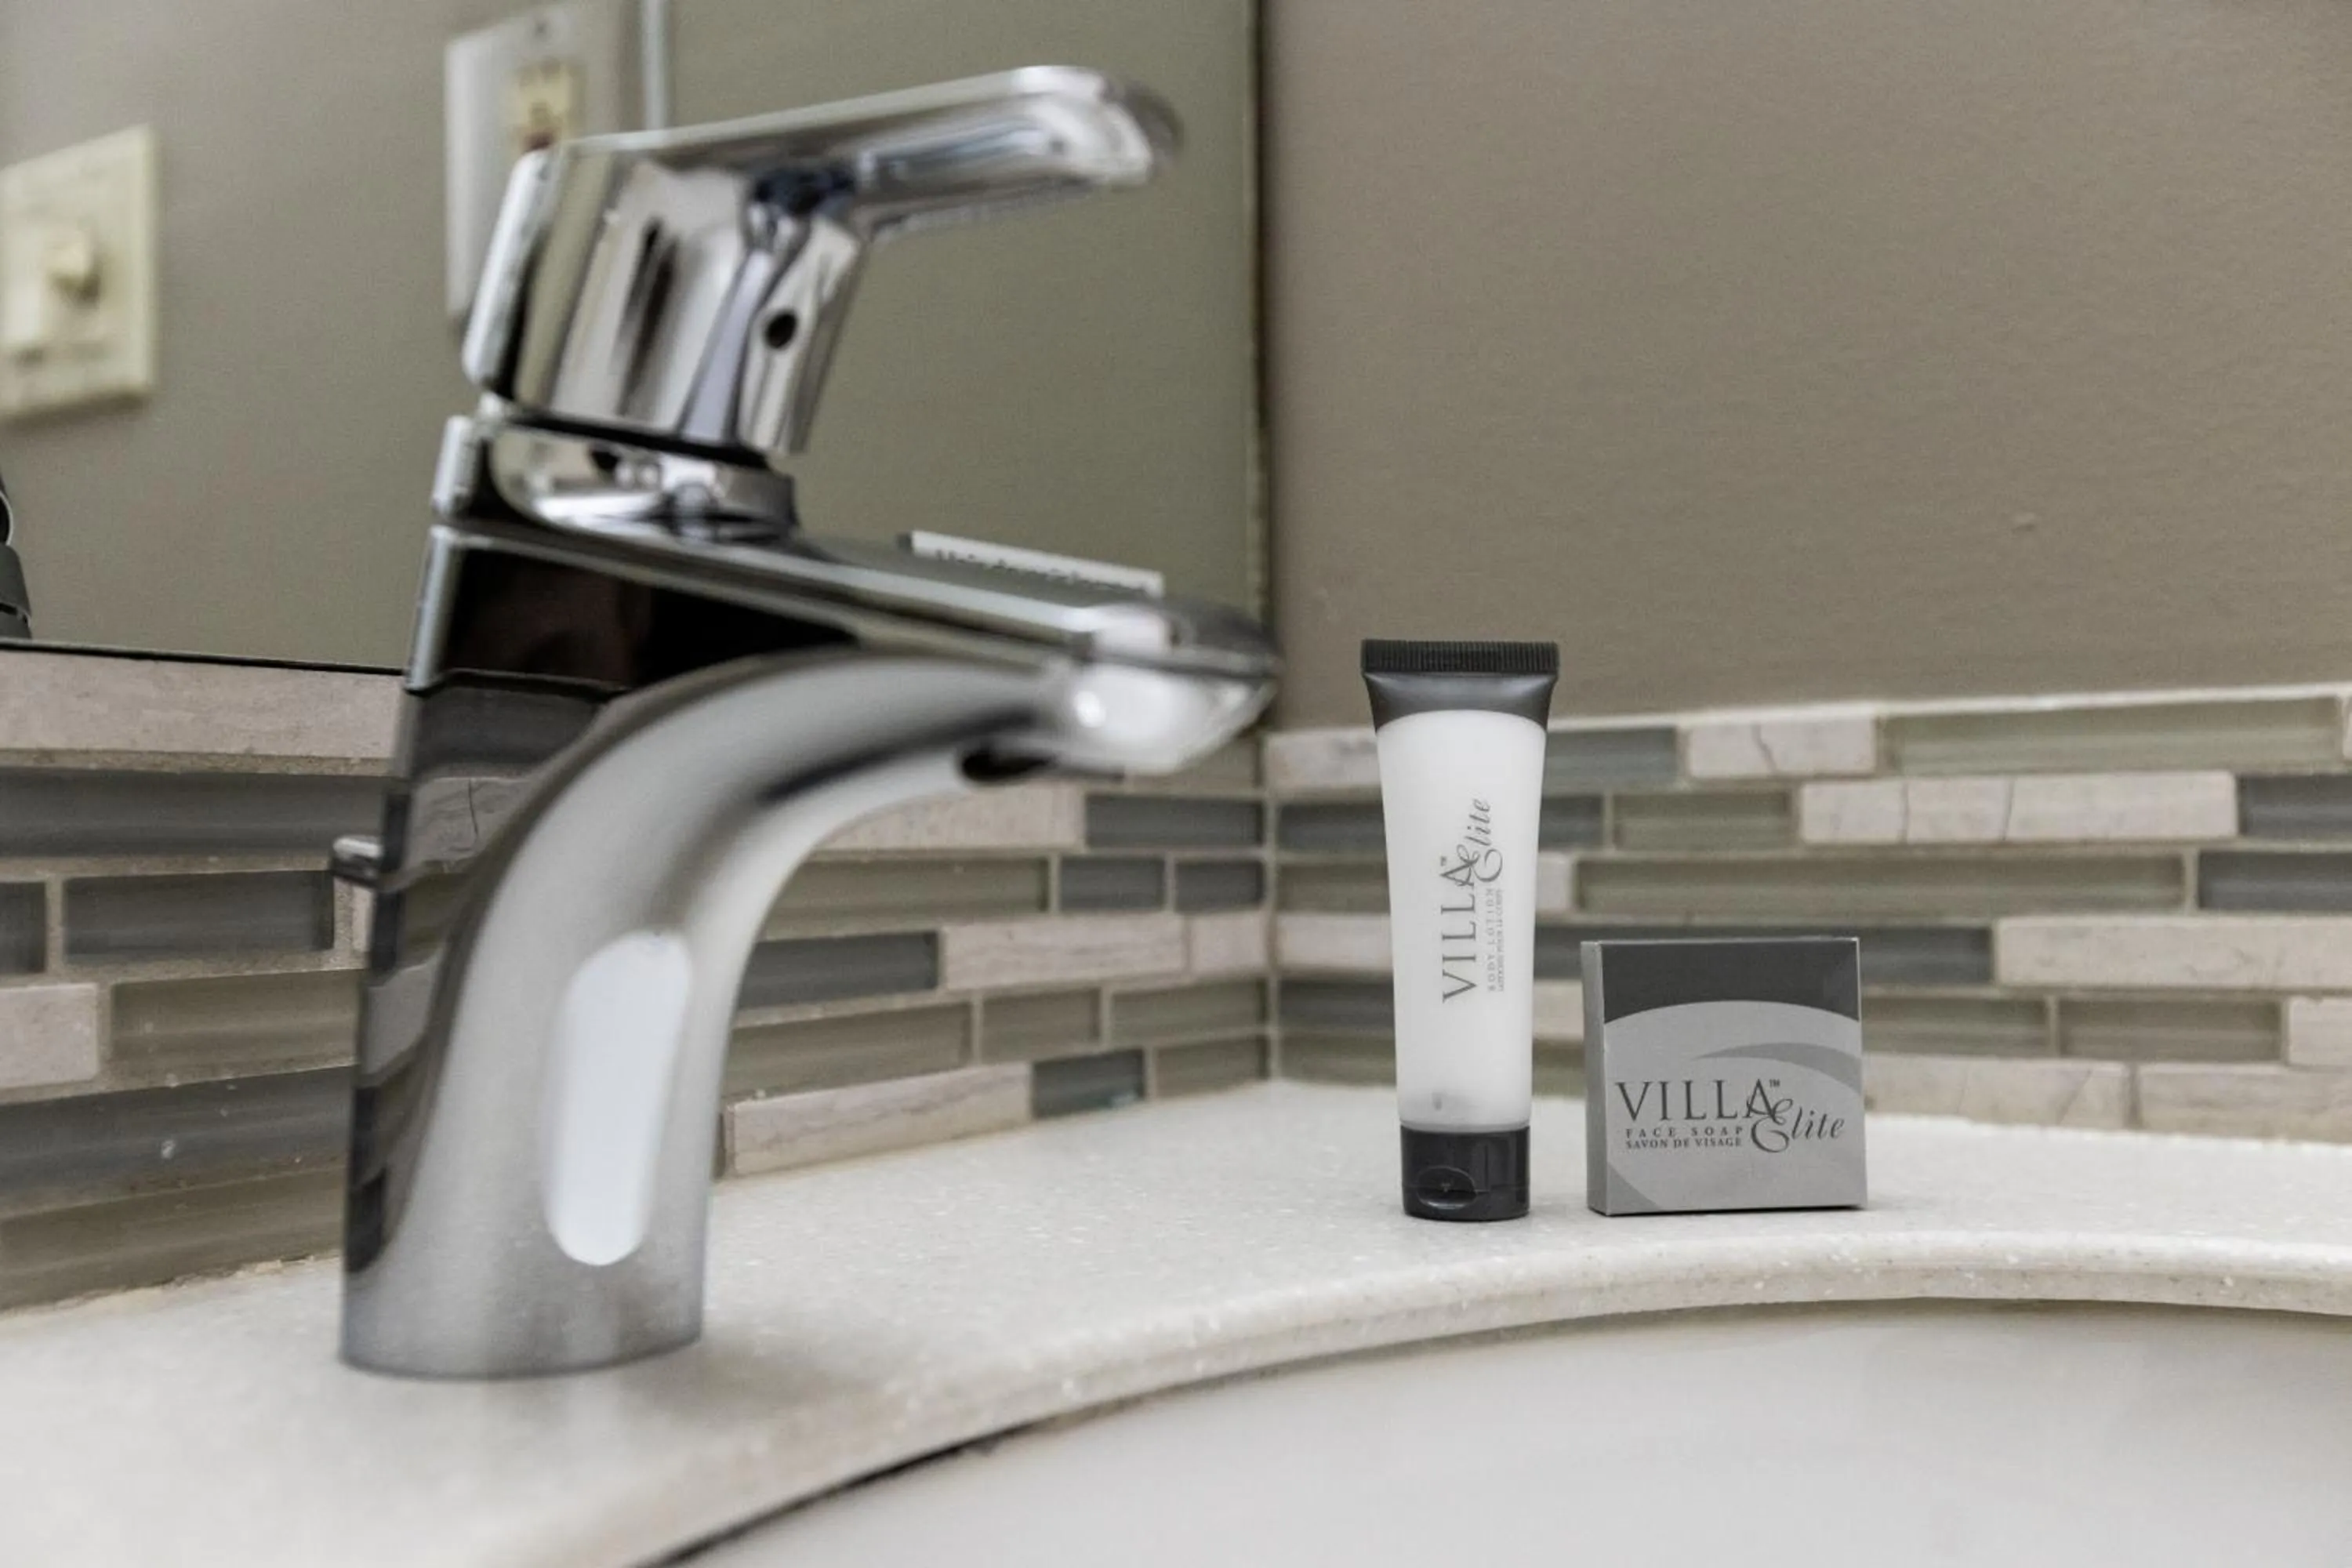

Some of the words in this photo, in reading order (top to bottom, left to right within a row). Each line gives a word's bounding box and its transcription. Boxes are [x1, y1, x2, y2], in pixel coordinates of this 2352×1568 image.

[1457, 798, 1503, 883] Elite
[1439, 862, 1477, 1004] VILLA
[1615, 1078, 1778, 1121] VILLA
[1751, 1098, 1845, 1153] Elite
[1625, 1127, 1677, 1138] FACE
[1690, 1126, 1743, 1137] SOAP
[1626, 1138, 1668, 1149] SAVON
[1673, 1138, 1690, 1149] DE
[1694, 1138, 1742, 1149] VISAGE
